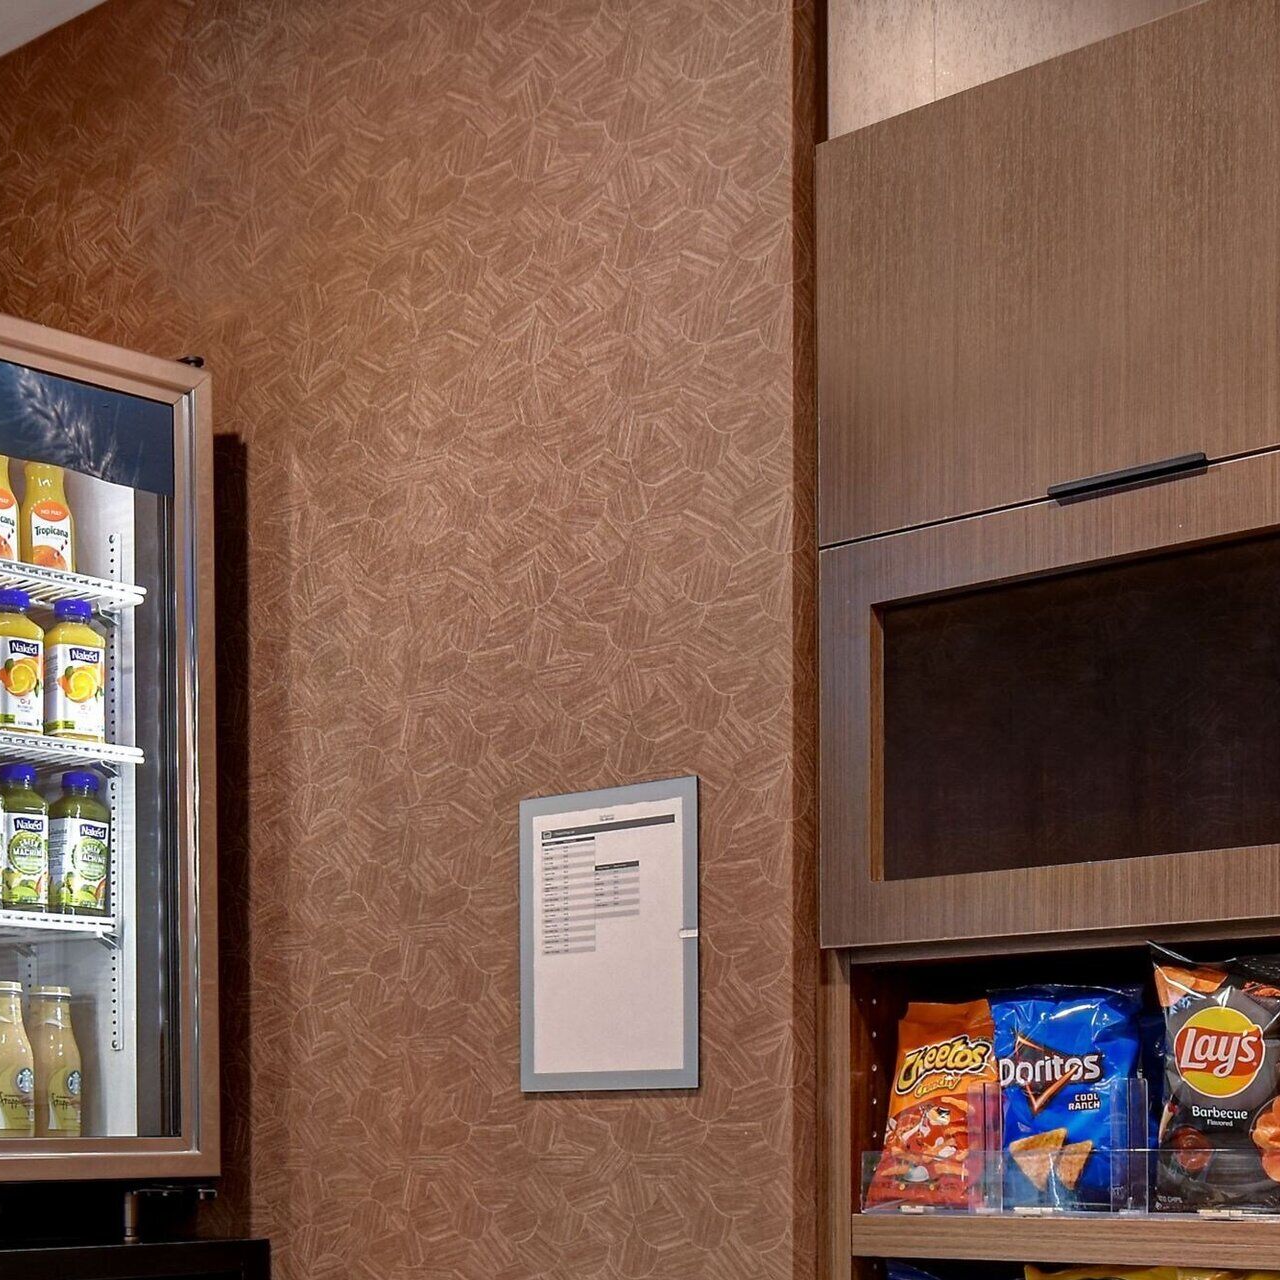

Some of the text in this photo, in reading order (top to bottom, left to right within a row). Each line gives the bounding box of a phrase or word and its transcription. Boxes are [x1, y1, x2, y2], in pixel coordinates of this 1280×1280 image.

[34, 525, 68, 538] Tropicana
[1180, 1028, 1257, 1076] Lay's
[897, 1035, 993, 1094] Cheetos
[999, 1054, 1101, 1086] Doritos
[1075, 1093, 1098, 1101] COOL
[1068, 1101, 1100, 1110] RANCH
[1192, 1105, 1248, 1121] Barbecue
[1207, 1119, 1233, 1127] Flavored
